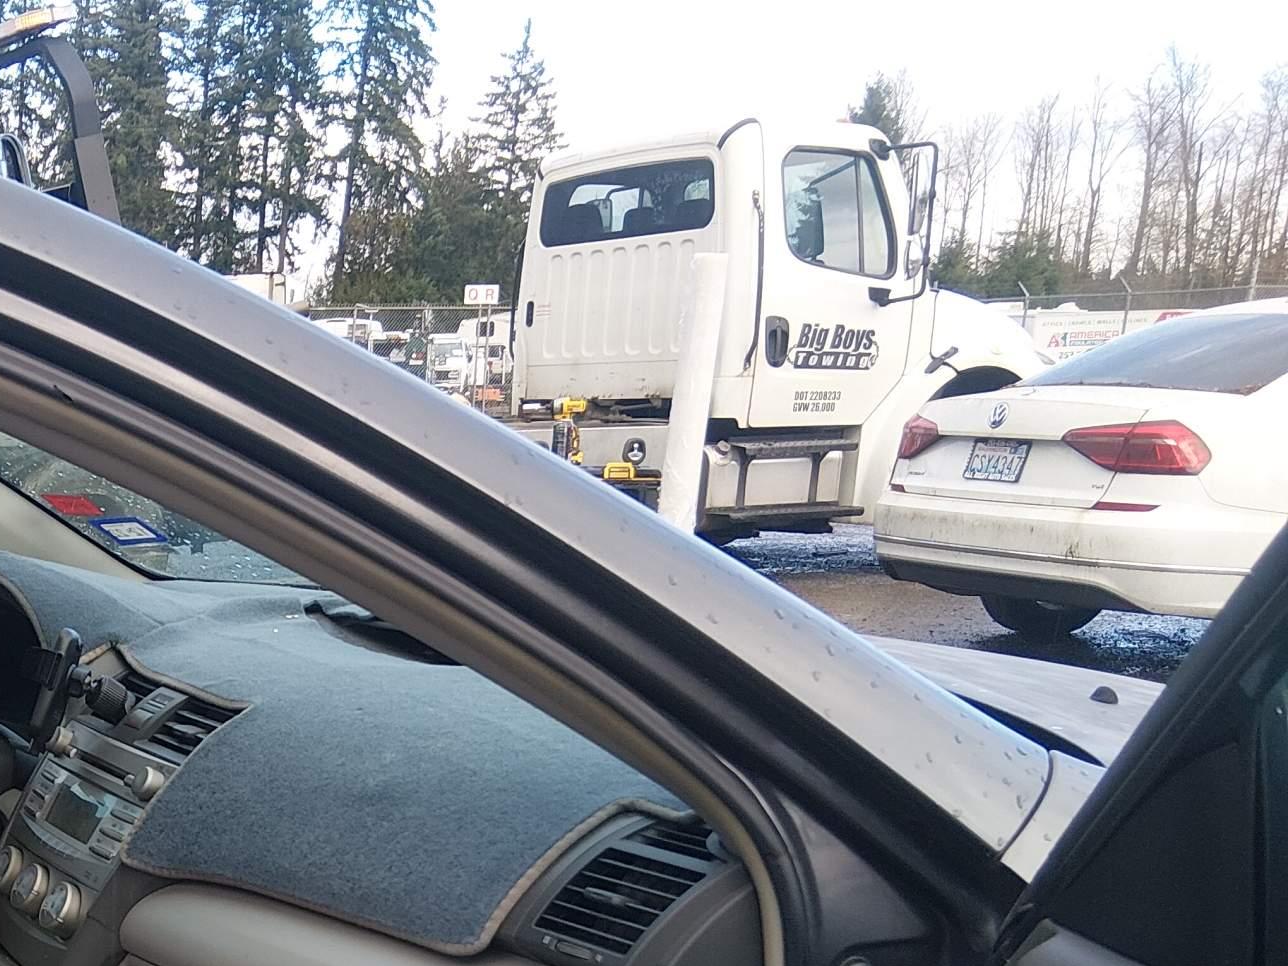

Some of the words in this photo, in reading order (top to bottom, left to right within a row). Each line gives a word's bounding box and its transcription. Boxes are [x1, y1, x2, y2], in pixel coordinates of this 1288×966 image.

[485, 288, 495, 301] R
[797, 323, 830, 351] Big
[829, 324, 876, 352] Boys
[794, 391, 809, 401] DOT
[792, 402, 810, 413] GVW
